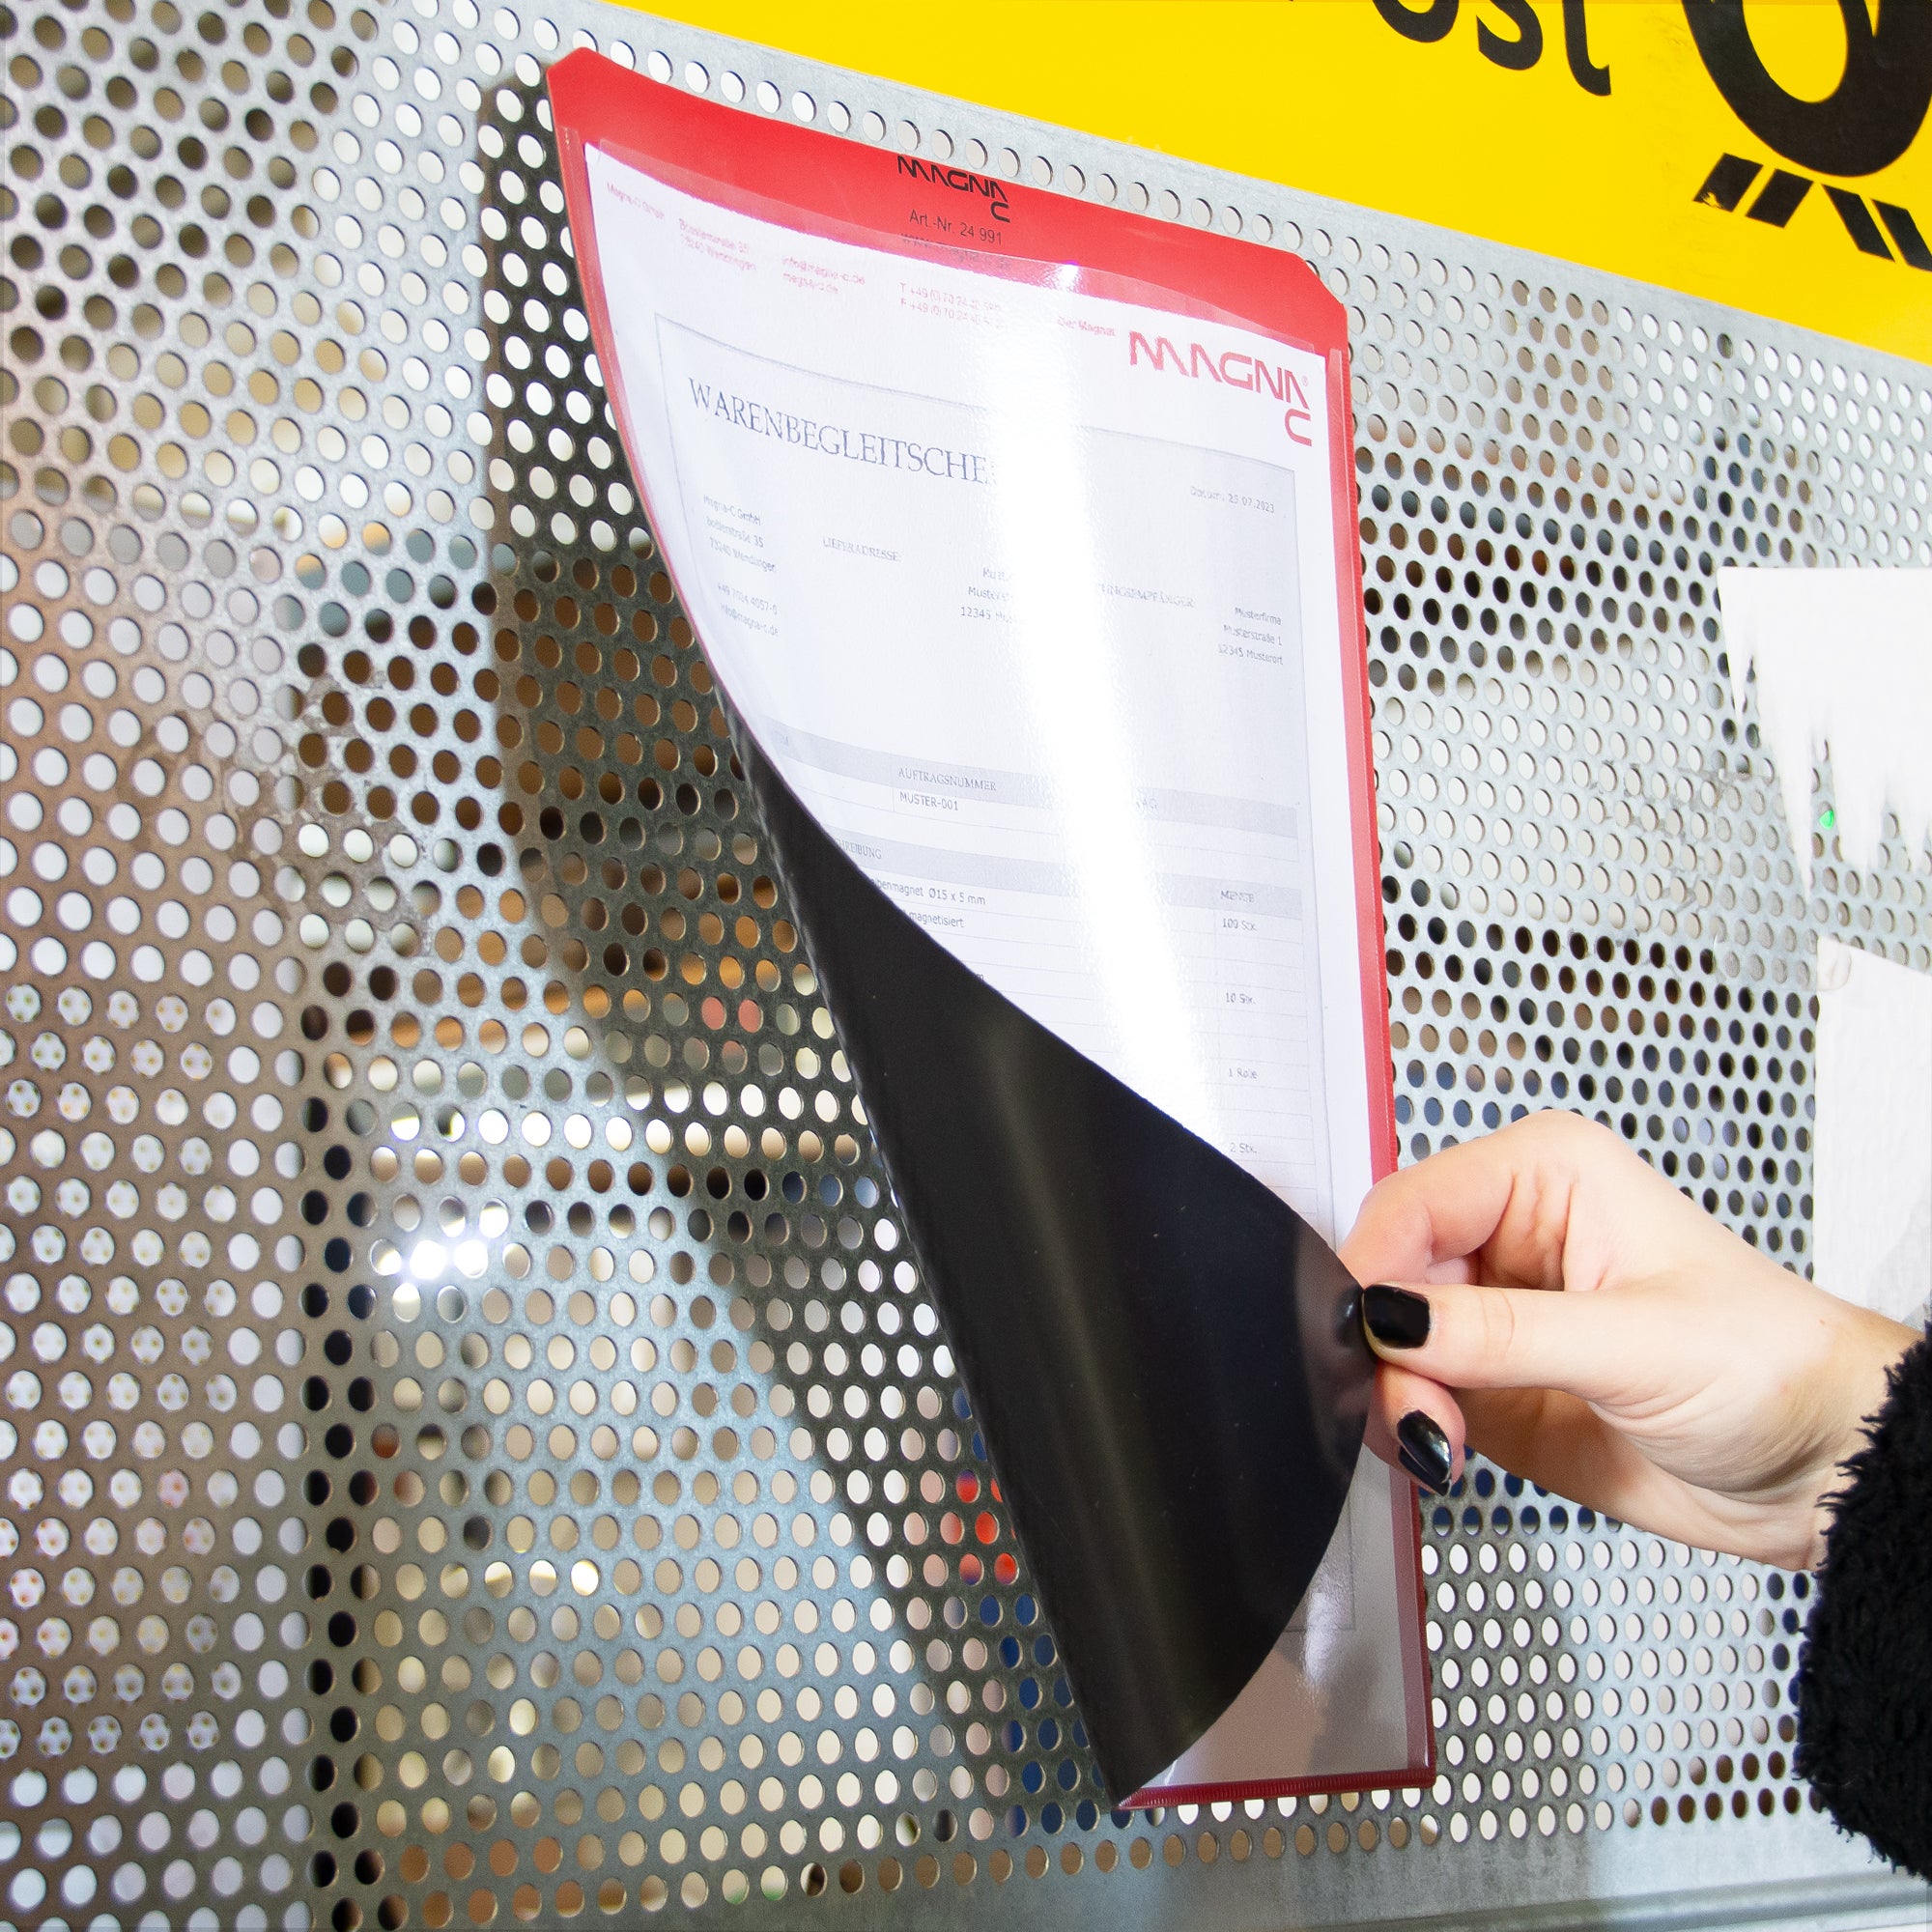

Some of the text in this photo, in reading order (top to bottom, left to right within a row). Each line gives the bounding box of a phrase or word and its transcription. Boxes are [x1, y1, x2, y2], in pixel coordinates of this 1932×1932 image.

[897, 155, 1009, 202] MAGNA
[960, 221, 975, 238] 24
[980, 227, 1003, 245] 991
[1129, 329, 1310, 410] MAGNA
[960, 606, 991, 621] 12345
[897, 767, 997, 791] AUFTRAGSNUMMER
[899, 791, 959, 811] MUSTER-001
[967, 895, 986, 905] mm
